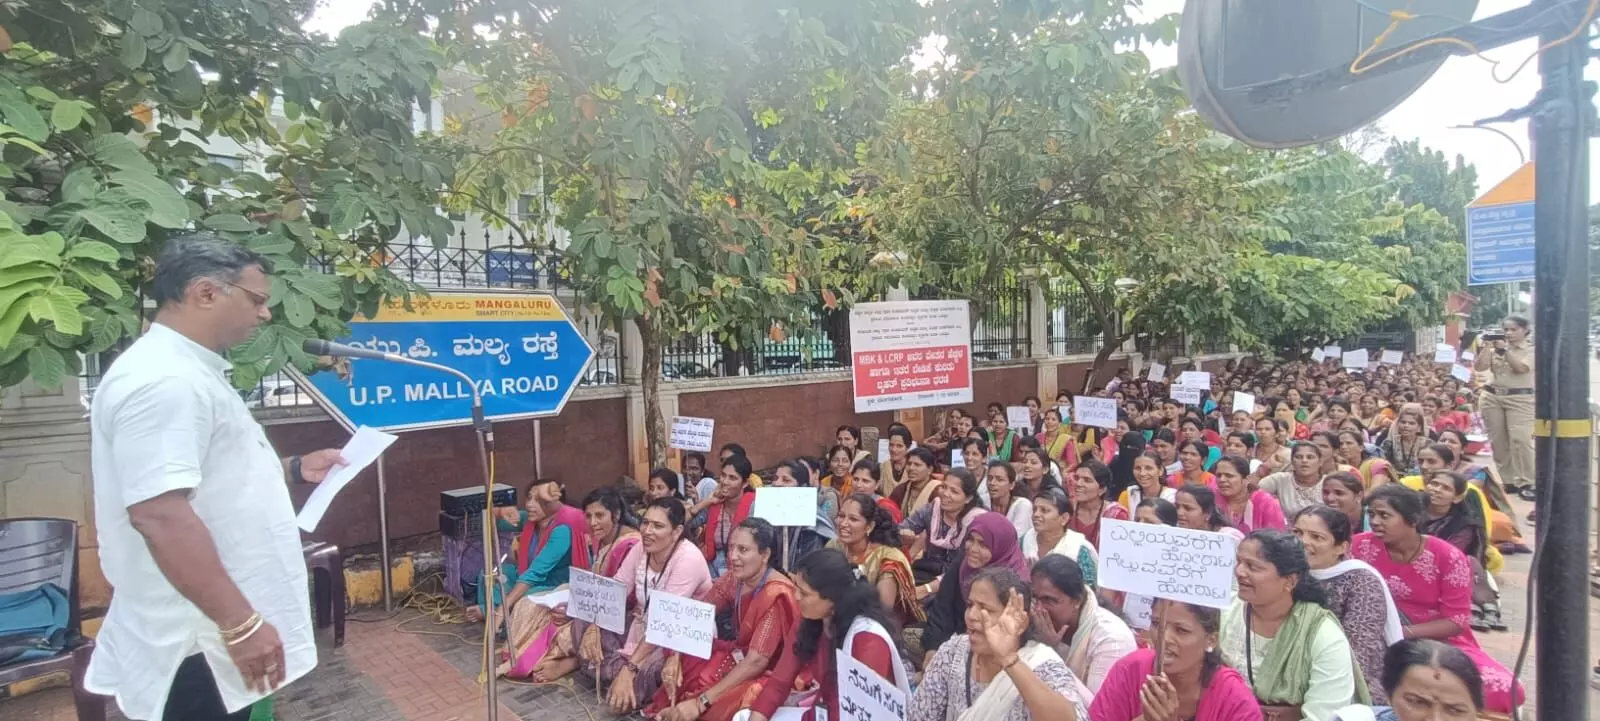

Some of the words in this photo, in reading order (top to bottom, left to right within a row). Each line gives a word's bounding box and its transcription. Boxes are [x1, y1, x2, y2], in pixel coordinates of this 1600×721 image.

[475, 299, 552, 310] MANGALURU
[452, 332, 512, 366] ಮಲ್ಯ
[521, 331, 559, 361] ರಸ್ತೆ
[350, 386, 396, 407] U.P.
[404, 379, 498, 402] MALLYA
[500, 374, 559, 396] ROAD
[1161, 546, 1233, 568] ಹೋರಾಟ
[1157, 577, 1226, 600] ಹೋರಾಟ
